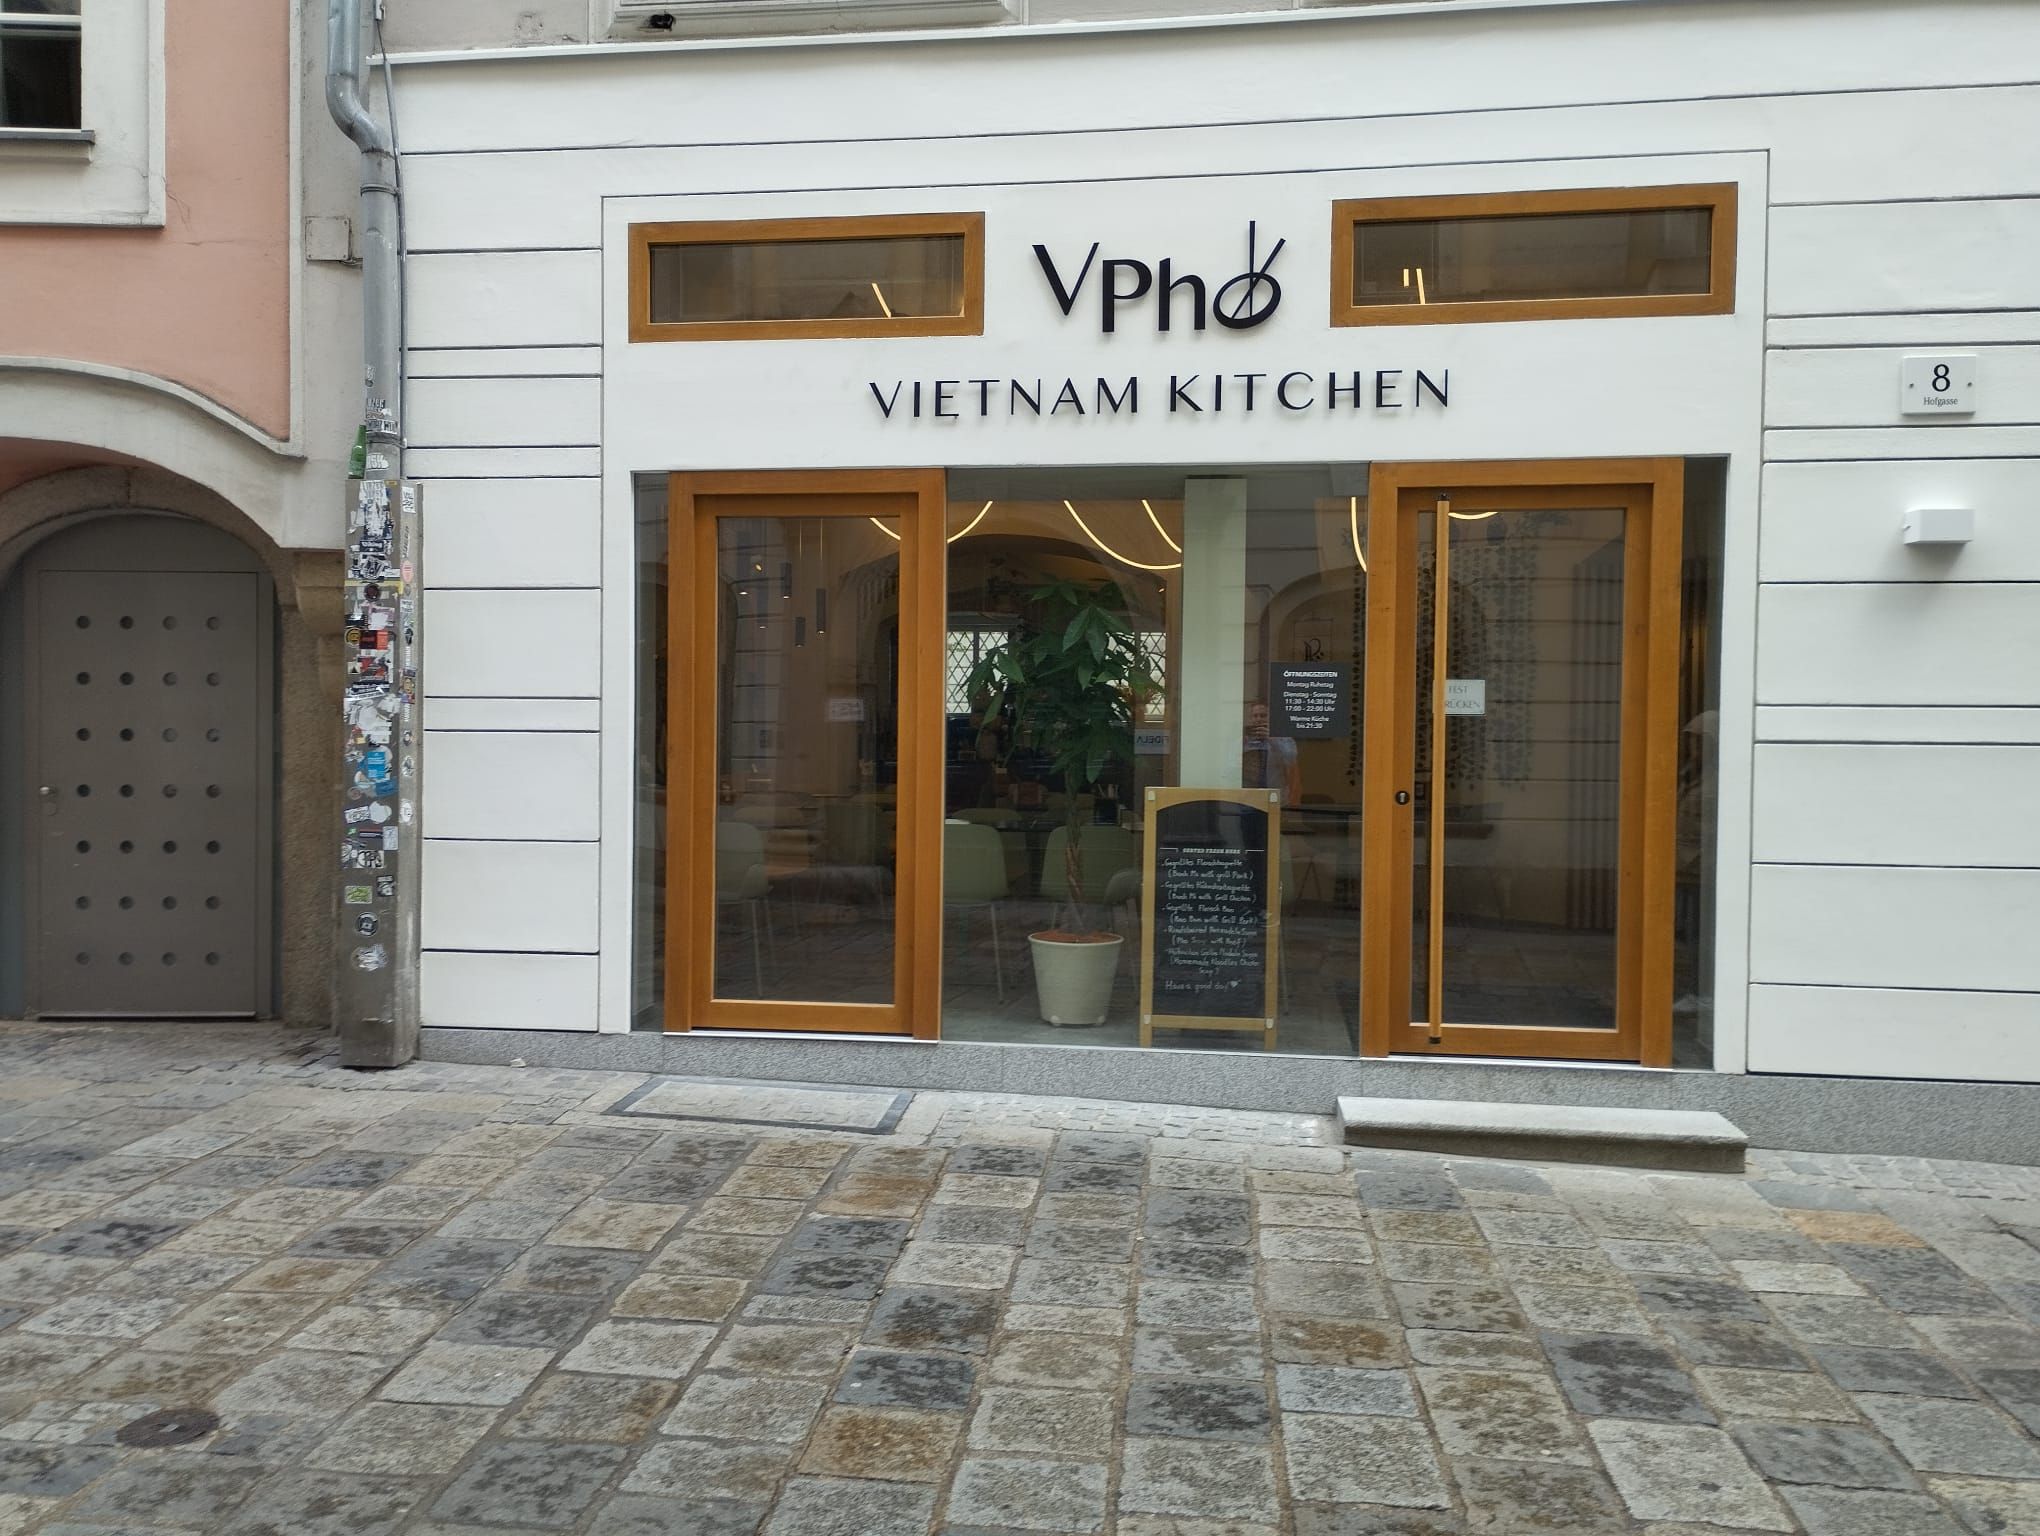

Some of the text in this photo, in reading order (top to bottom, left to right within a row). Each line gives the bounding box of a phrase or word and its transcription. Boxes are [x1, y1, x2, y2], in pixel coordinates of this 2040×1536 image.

[1932, 364, 1951, 392] 8
[869, 369, 1449, 419] VIETNAM KITCHEN
[1924, 396, 1959, 407] Hofgasse
[1283, 670, 1338, 678] ÖFFNUNGSZEITEN
